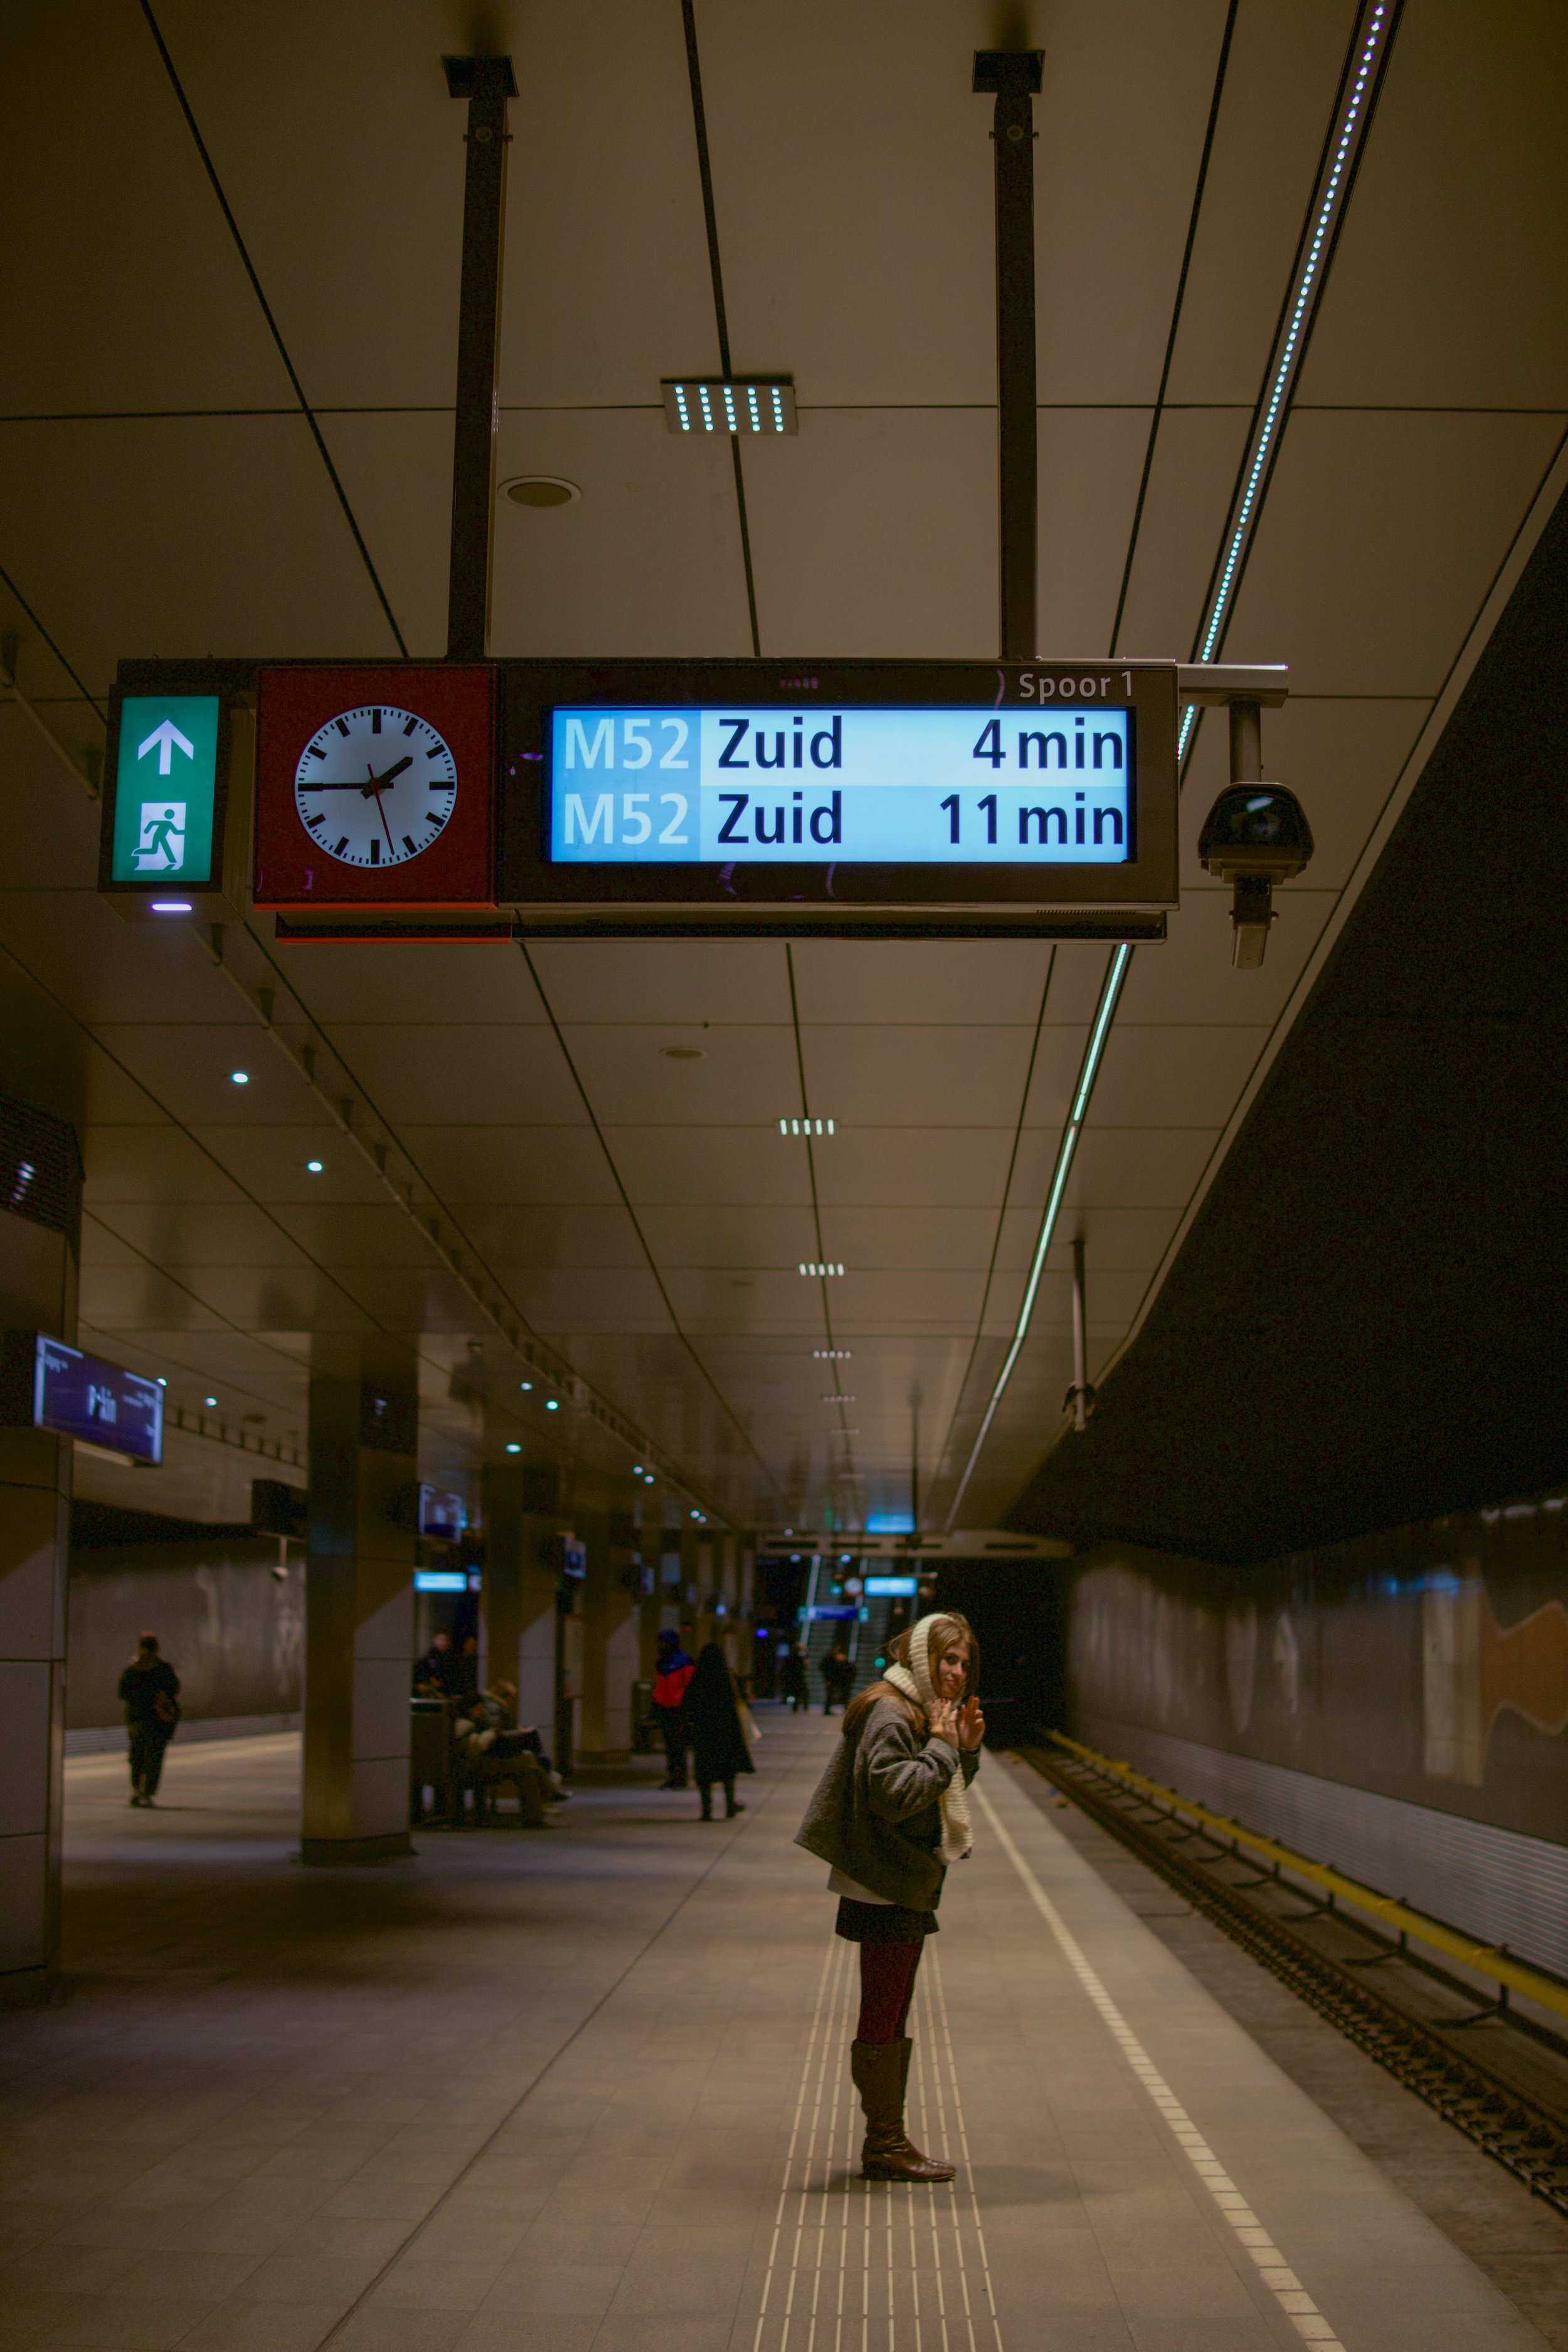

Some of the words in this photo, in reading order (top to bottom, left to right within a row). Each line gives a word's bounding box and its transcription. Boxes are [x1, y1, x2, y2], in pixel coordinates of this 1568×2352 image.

[1019, 673, 1111, 705] Spoor
[1121, 670, 1132, 697] 1
[565, 718, 689, 770] M52
[718, 715, 842, 769] Zuid
[973, 719, 1007, 769] 4
[1019, 717, 1123, 769] min
[564, 793, 689, 844] M52
[718, 790, 842, 844] Zuid
[940, 793, 997, 844] 11
[1019, 792, 1123, 844] min
